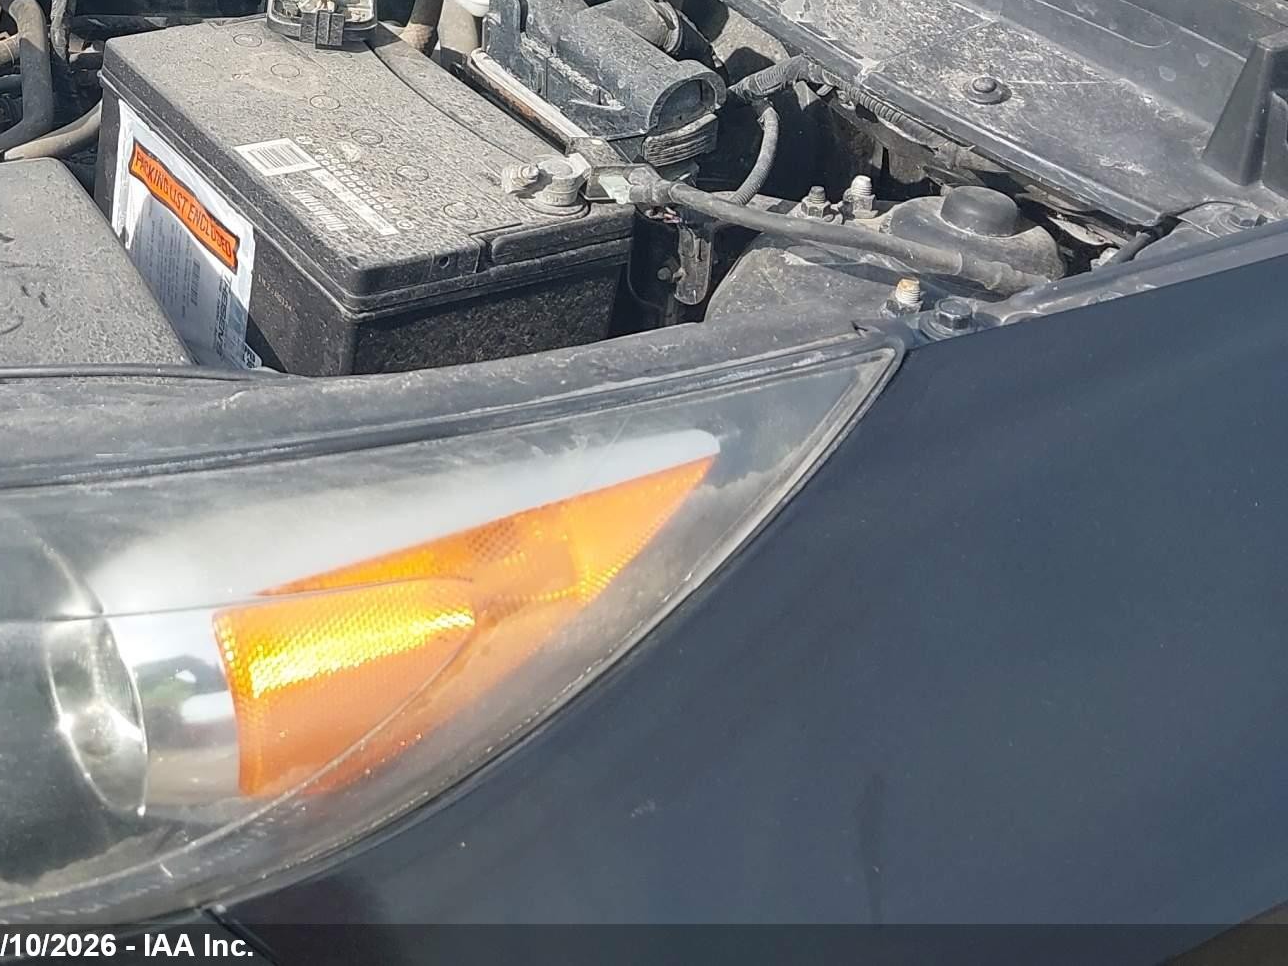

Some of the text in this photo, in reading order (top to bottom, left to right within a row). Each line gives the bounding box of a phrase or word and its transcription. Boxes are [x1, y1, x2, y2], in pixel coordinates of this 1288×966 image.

[135, 151, 169, 194] PACKING
[168, 186, 190, 214] LIST
[187, 205, 232, 258] ENCLOSED
